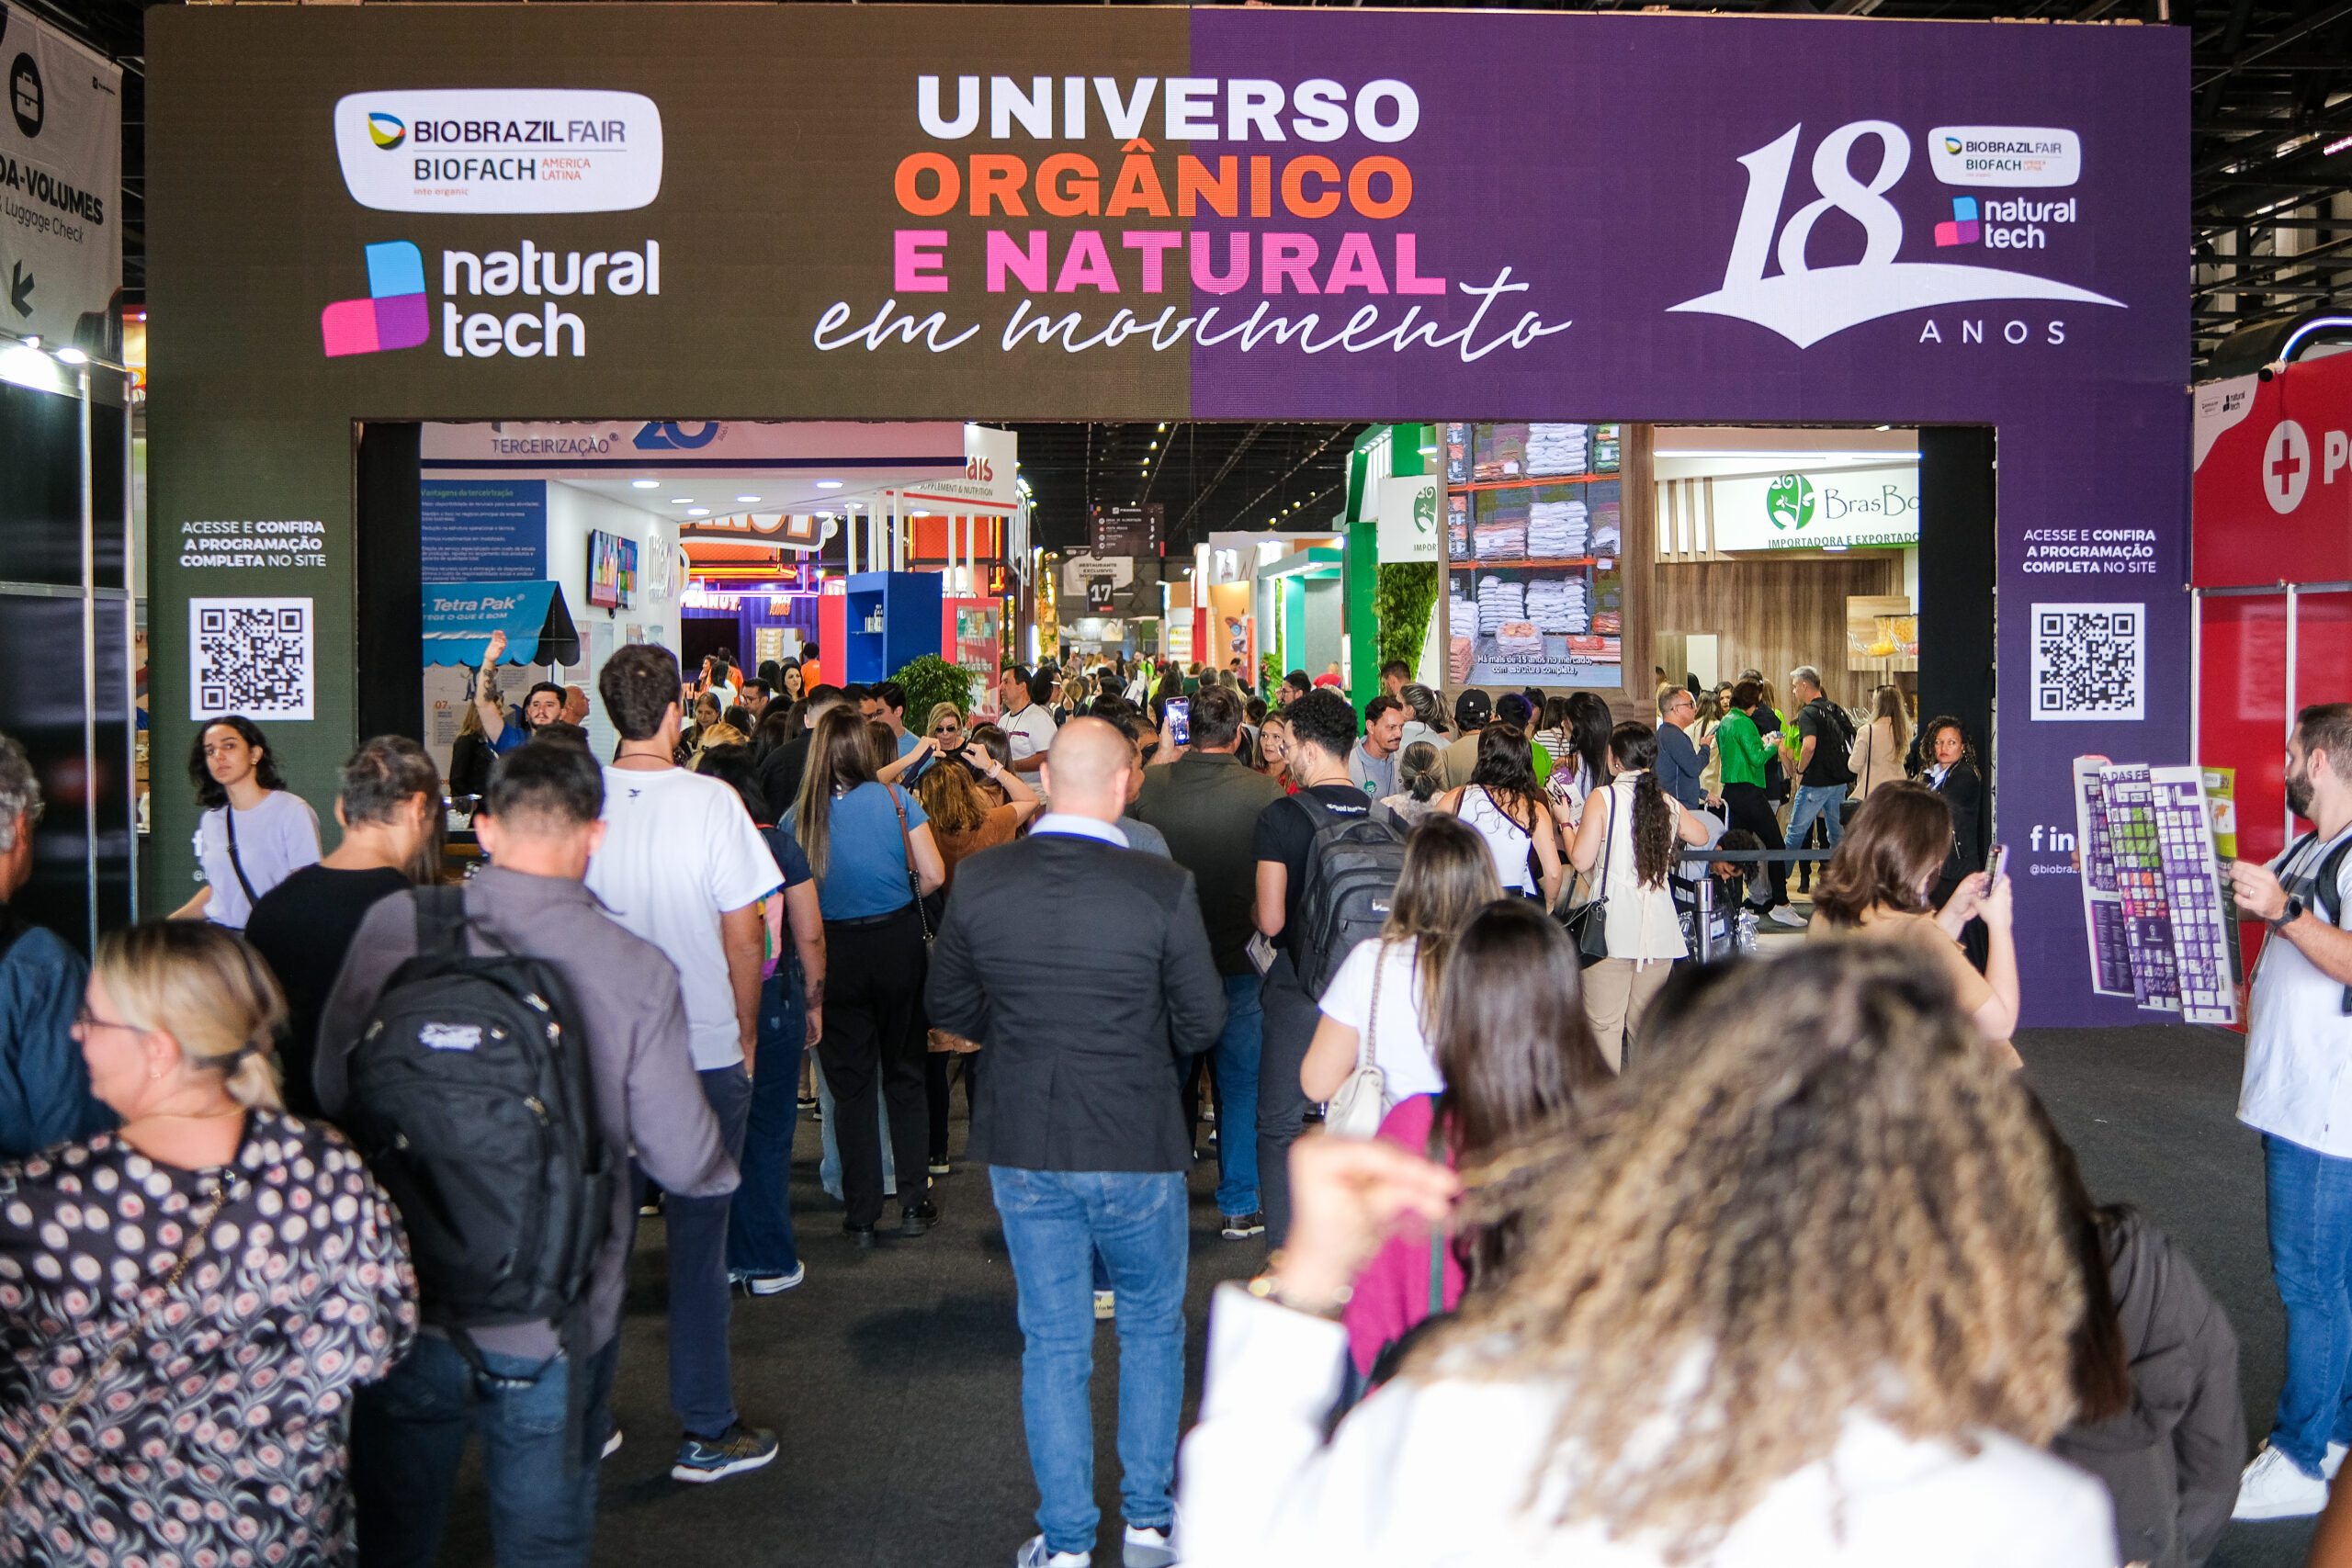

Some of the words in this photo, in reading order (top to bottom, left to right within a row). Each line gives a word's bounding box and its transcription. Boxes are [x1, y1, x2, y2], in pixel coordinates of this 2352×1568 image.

[918, 75, 1420, 142] UNIVERSO
[413, 159, 537, 181] BIOFACH
[542, 158, 591, 169] AMERICA
[1966, 159, 2022, 171] BIOFACH
[542, 170, 582, 181] LATINA
[894, 138, 1414, 220] ORGÂNICO
[1736, 119, 1912, 290] 18
[1984, 197, 2076, 223] natural
[6, 196, 50, 233] Luggage
[52, 217, 84, 244] Check
[1984, 223, 2045, 249] tech
[442, 239, 661, 296] natural
[893, 230, 949, 293] E
[986, 230, 1448, 296] NATURAL
[812, 299, 980, 353] em
[1001, 265, 1573, 362] movimento
[442, 301, 586, 358] tech
[1918, 319, 2066, 345] ANOS
[2324, 430, 2352, 485] P
[964, 486, 993, 497] NUTRITION
[1825, 484, 1919, 520] BrasBo
[181, 521, 240, 534] ACESSE
[243, 522, 253, 533] E
[254, 521, 325, 534] CONFIRA
[2023, 529, 2077, 541] ACESSE
[2081, 529, 2089, 541] E
[2092, 529, 2156, 542] CONFIRA
[185, 538, 198, 551] A
[198, 536, 322, 553] PROGRAMAÇÃO
[1769, 536, 1844, 549] IMPORTADORA
[1847, 536, 1852, 545] E
[2026, 546, 2038, 558] A
[2040, 543, 2154, 560] PROGRAMAÇÃO
[180, 555, 265, 567] COMPLETA
[267, 555, 291, 566] NO
[294, 555, 326, 567] SITE
[2022, 561, 2100, 573] COMPLETA
[2103, 561, 2125, 573] NO
[2128, 561, 2157, 573] SITE
[1091, 584, 1112, 603] 17
[434, 598, 478, 612] Tetra
[1488, 655, 1505, 664] mais
[1528, 656, 1545, 664] anos
[1547, 656, 1557, 664] no
[1558, 655, 1593, 666] mercado,
[1492, 666, 1508, 674] com
[1542, 665, 1578, 676] completa,
[2111, 771, 2133, 781] DAS
